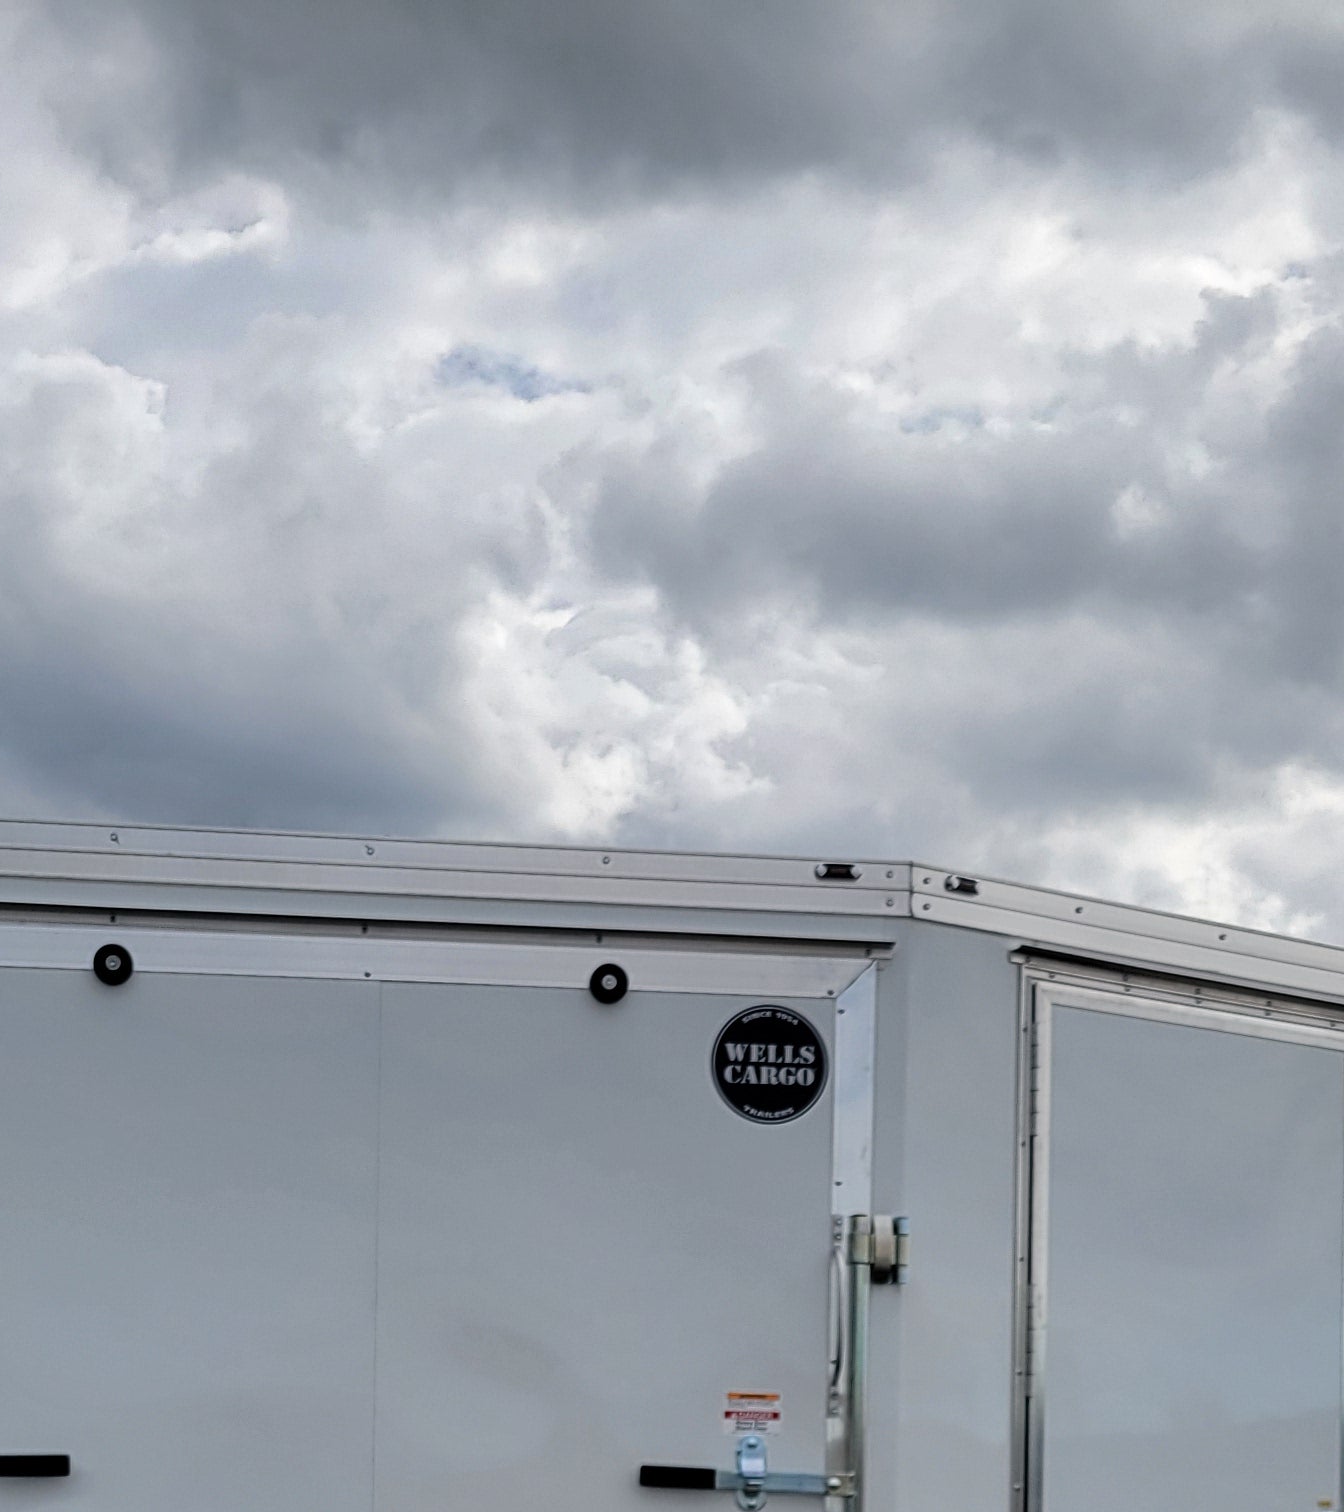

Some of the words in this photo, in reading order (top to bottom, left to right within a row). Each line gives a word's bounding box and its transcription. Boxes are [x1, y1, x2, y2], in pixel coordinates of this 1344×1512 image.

[725, 1043, 816, 1065] WELLS
[723, 1065, 816, 1086] CARGO
[743, 1105, 794, 1118] TRAILERS
